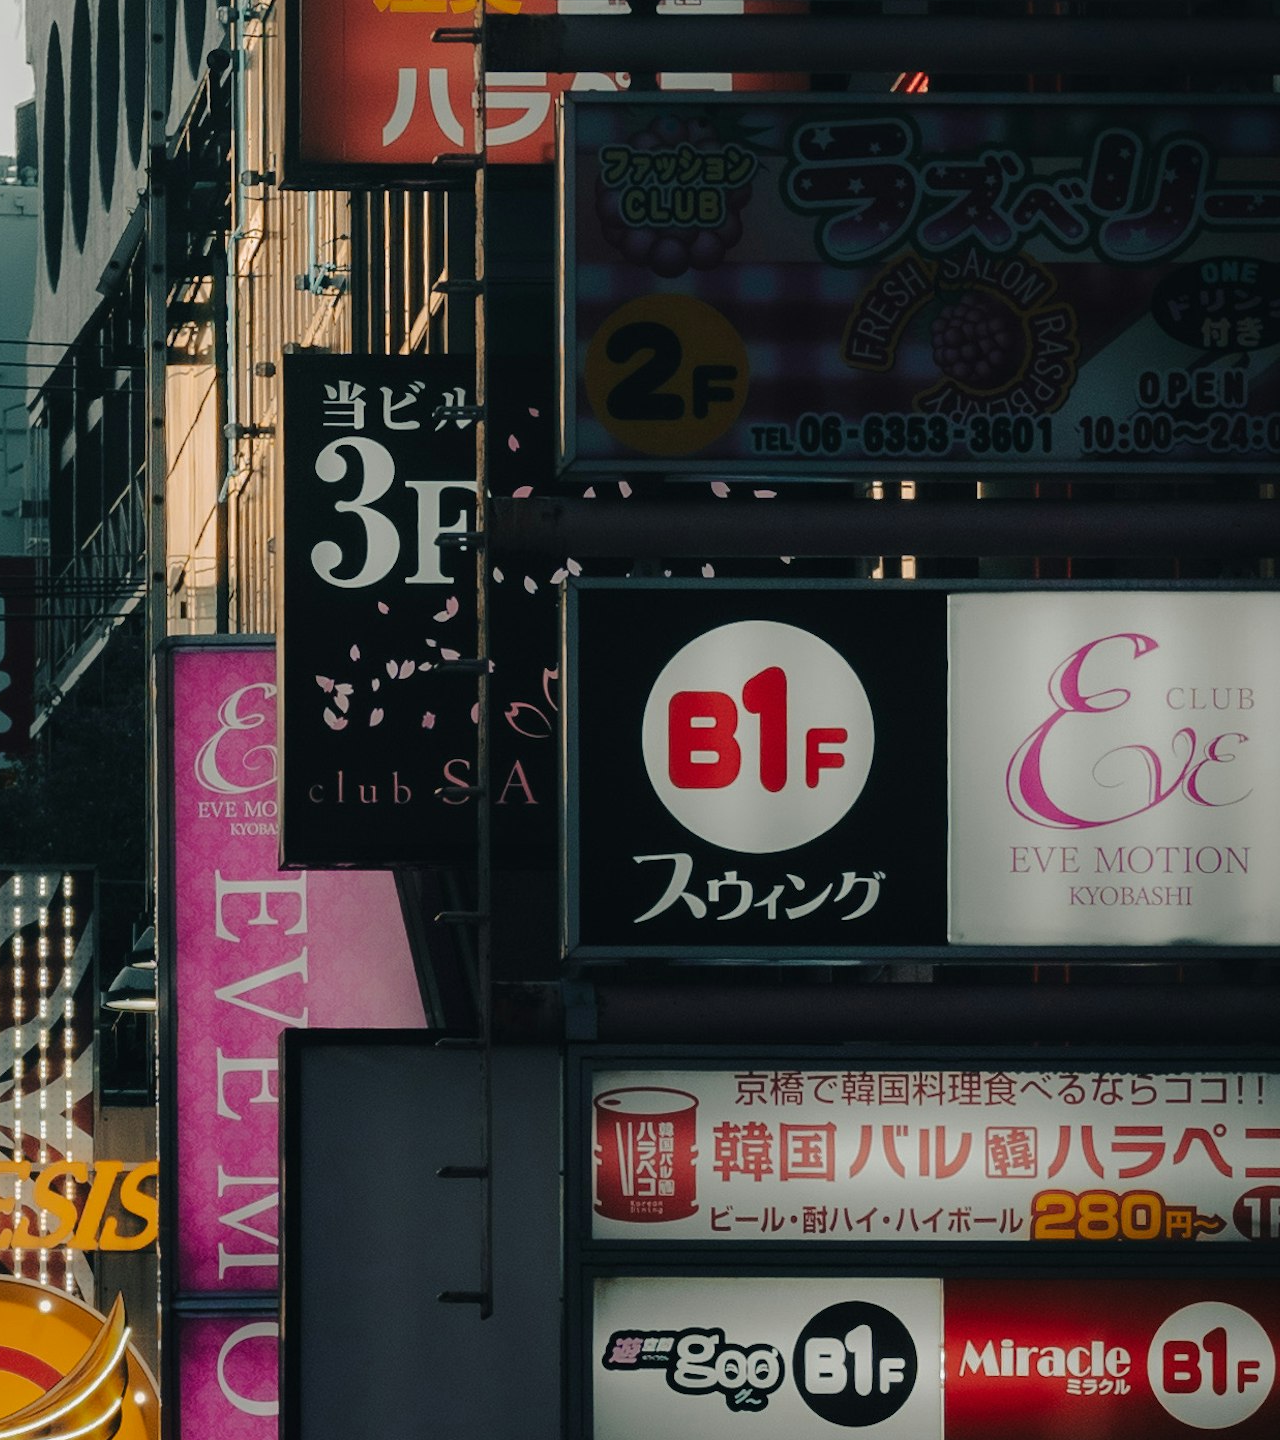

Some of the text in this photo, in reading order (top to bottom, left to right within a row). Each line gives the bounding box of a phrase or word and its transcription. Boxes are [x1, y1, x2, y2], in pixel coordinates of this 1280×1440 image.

[602, 146, 754, 186] ファッション
[622, 189, 726, 225] CLUB
[1199, 261, 1258, 286] ONE
[851, 262, 933, 368] FRESH
[941, 247, 1047, 306] SALON
[1199, 317, 1265, 348] 付き
[605, 321, 740, 422] 2F
[1138, 370, 1250, 409] OPEN
[322, 379, 476, 432] 当ビル
[752, 426, 796, 454] TEL
[798, 416, 1054, 455] 06-6353-3601
[310, 435, 492, 589] 3F
[1166, 686, 1256, 711] CLUB
[667, 665, 849, 794] B1F
[307, 769, 413, 805] club
[197, 802, 237, 819] EVE
[1008, 845, 1250, 875] EVE MOTION
[632, 851, 887, 925] スウィング
[1069, 885, 1195, 907] KYOBASHI
[712, 1120, 973, 1183] 韓国バル
[673, 1333, 781, 1390] goo
[804, 1323, 905, 1396] B1F
[959, 1339, 1132, 1380] Miracle
[1163, 1324, 1260, 1397] B1F
[1066, 1379, 1132, 1396] ミラクル
